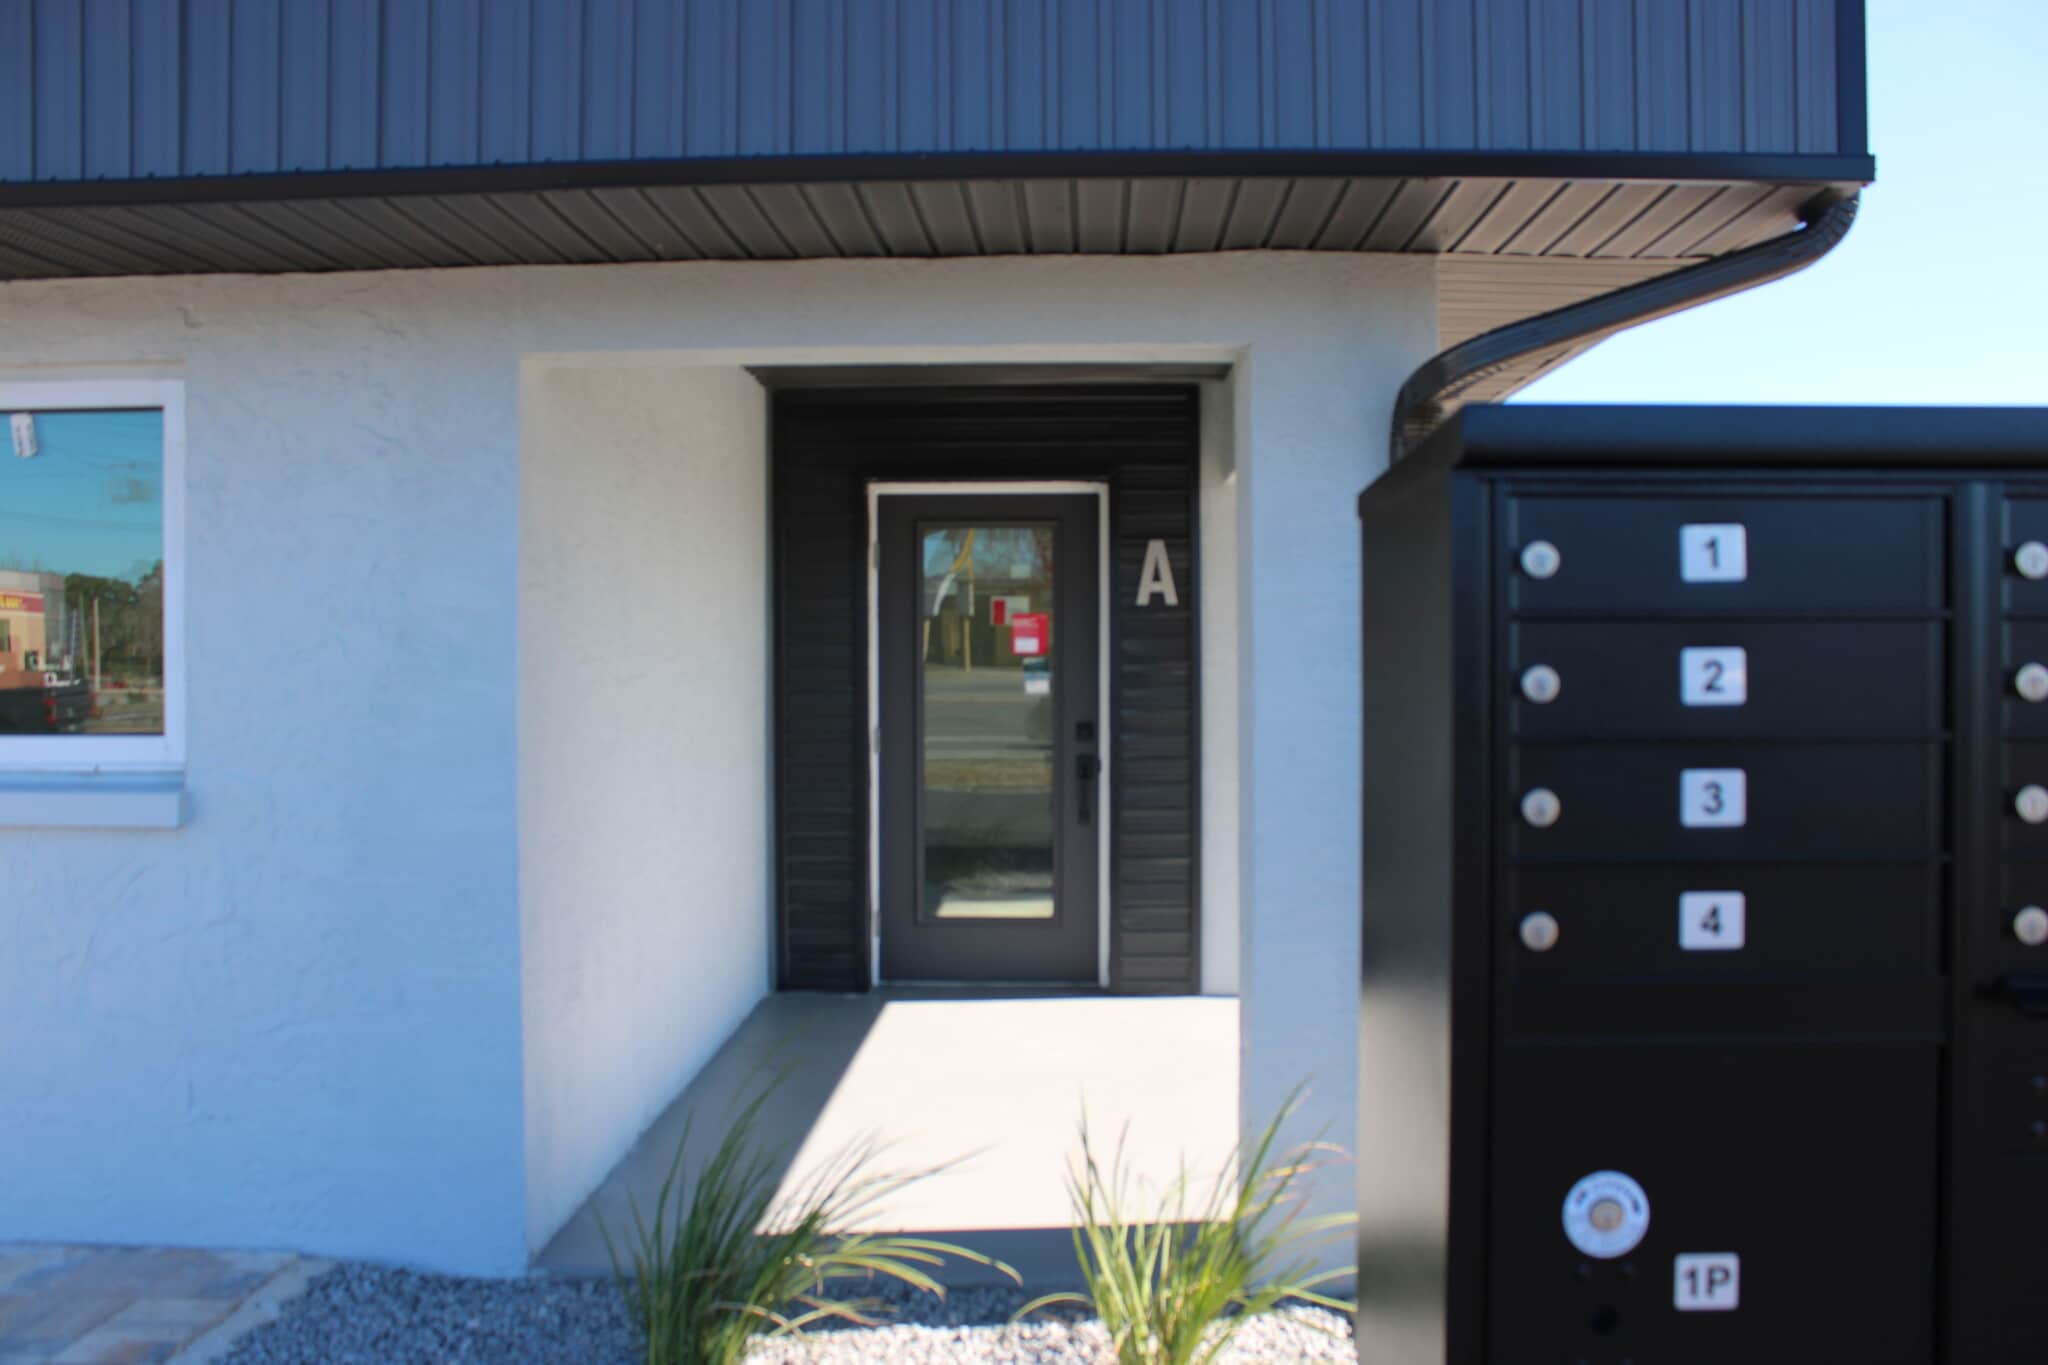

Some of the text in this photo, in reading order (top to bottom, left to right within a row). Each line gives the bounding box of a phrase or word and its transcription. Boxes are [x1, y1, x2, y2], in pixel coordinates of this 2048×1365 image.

[1702, 536, 1720, 570] 1
[1135, 539, 1178, 606] A
[1701, 660, 1725, 694] 2
[1701, 782, 1724, 816] 3
[1700, 905, 1722, 937] 4
[1683, 1265, 1731, 1297] 1P
